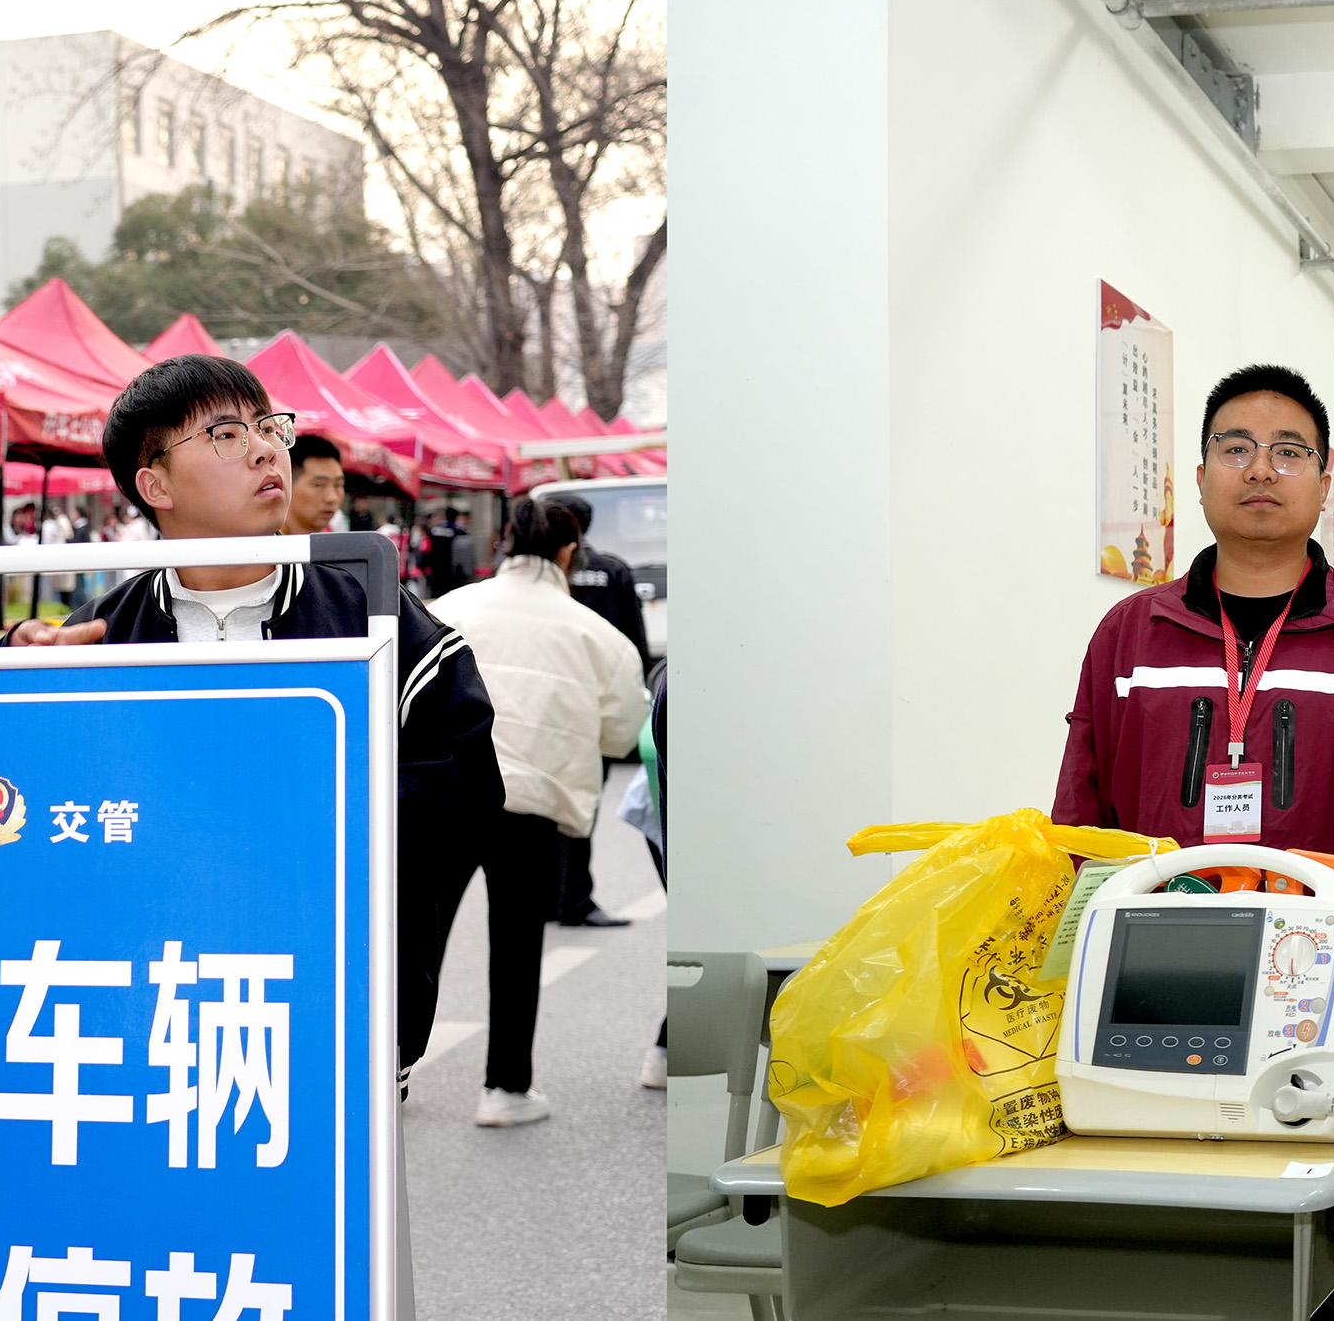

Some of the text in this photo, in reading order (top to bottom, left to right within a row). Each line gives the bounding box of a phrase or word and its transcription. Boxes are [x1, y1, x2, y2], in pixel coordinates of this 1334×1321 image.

[1216, 804, 1250, 813] 工作人员
[50, 798, 140, 844] 交管
[1005, 1000, 1050, 1024] 医疗废物
[1300, 1000, 1308, 1011] 2
[1002, 1020, 1033, 1039] MEDICAL
[1285, 1025, 1293, 1037] 3
